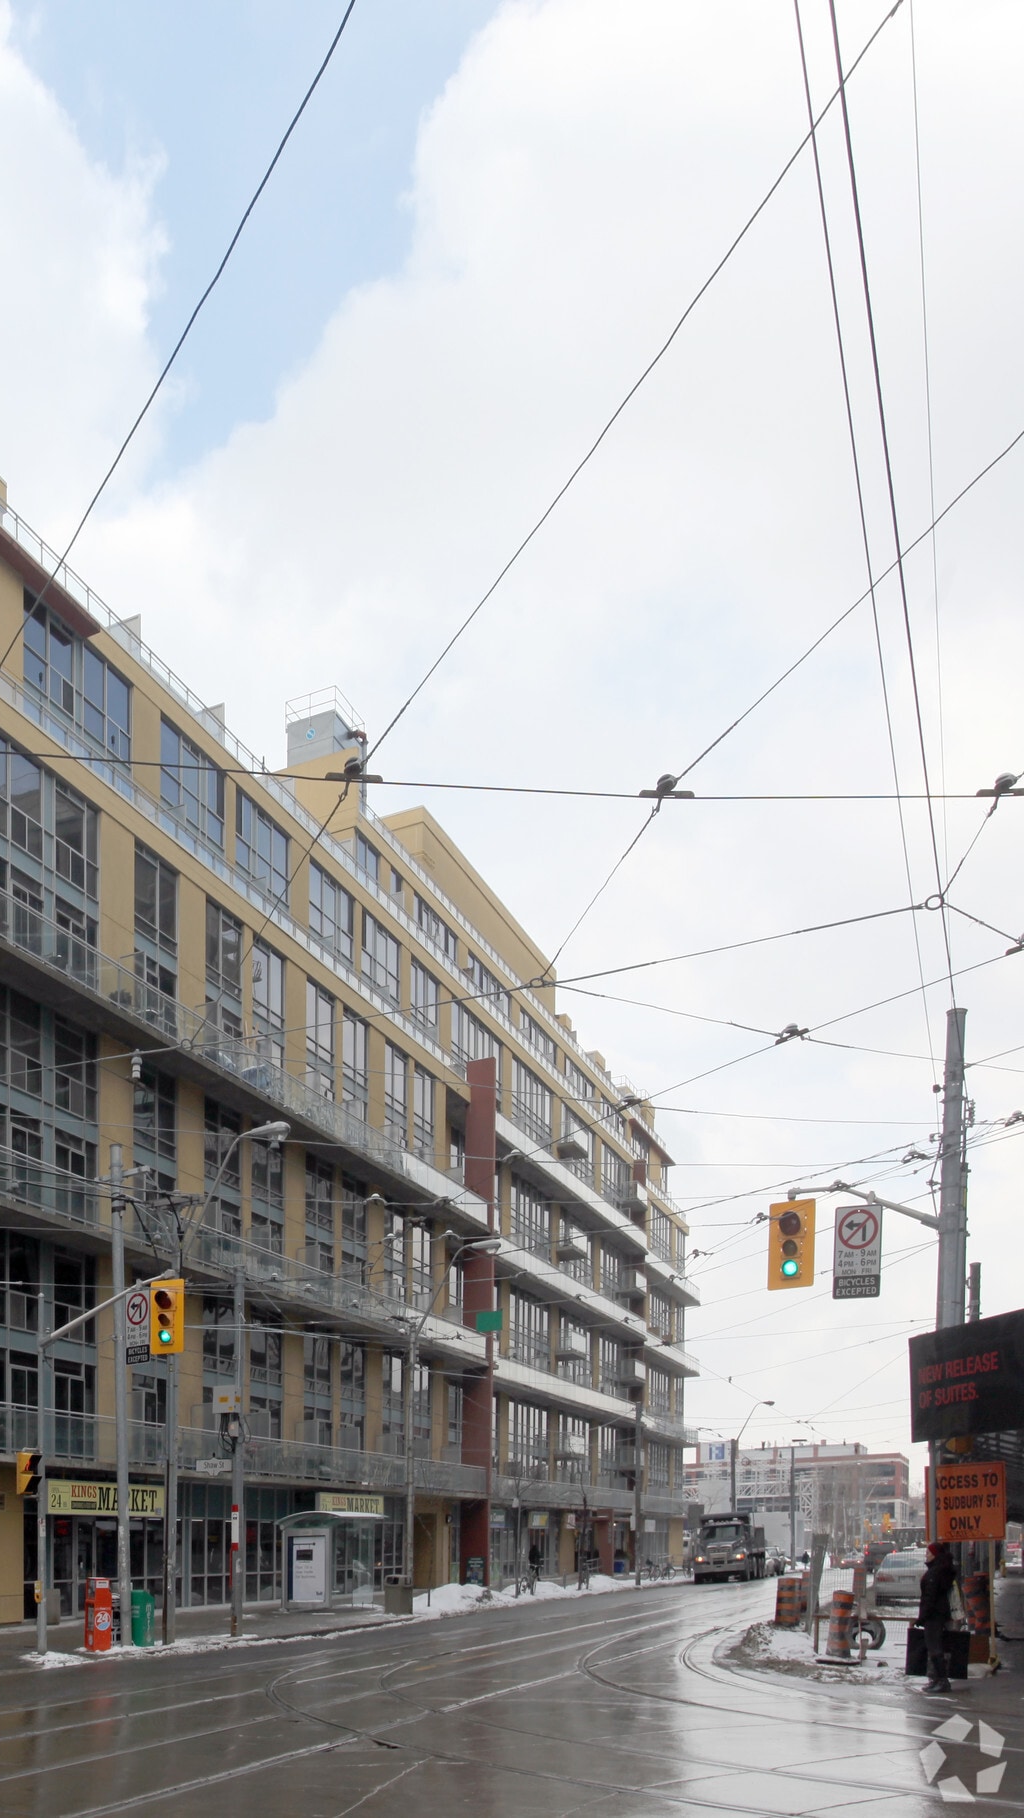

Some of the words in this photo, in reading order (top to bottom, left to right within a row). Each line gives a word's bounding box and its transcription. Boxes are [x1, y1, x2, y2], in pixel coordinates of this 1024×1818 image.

[838, 1277, 875, 1287] BICYCLES
[836, 1287, 877, 1296] EXCEPTED
[128, 1346, 148, 1355] BICYCLES
[127, 1354, 148, 1363] EXCEPTED
[918, 1363, 943, 1385] NEW
[946, 1351, 999, 1378] RELEASE
[919, 1390, 932, 1409] OF
[935, 1382, 979, 1406] SUITES.
[203, 1461, 218, 1469] Shaw
[218, 1461, 225, 1469] St
[982, 1472, 999, 1487] TO
[51, 1494, 62, 1508] 24
[71, 1485, 97, 1499] KINGS
[98, 1486, 158, 1512] MAKET
[346, 1497, 380, 1514] MARKET
[943, 1494, 984, 1510] SUDBURY
[986, 1493, 999, 1508] ST.
[949, 1516, 981, 1530] ONLY
[97, 1612, 108, 1623] 24
